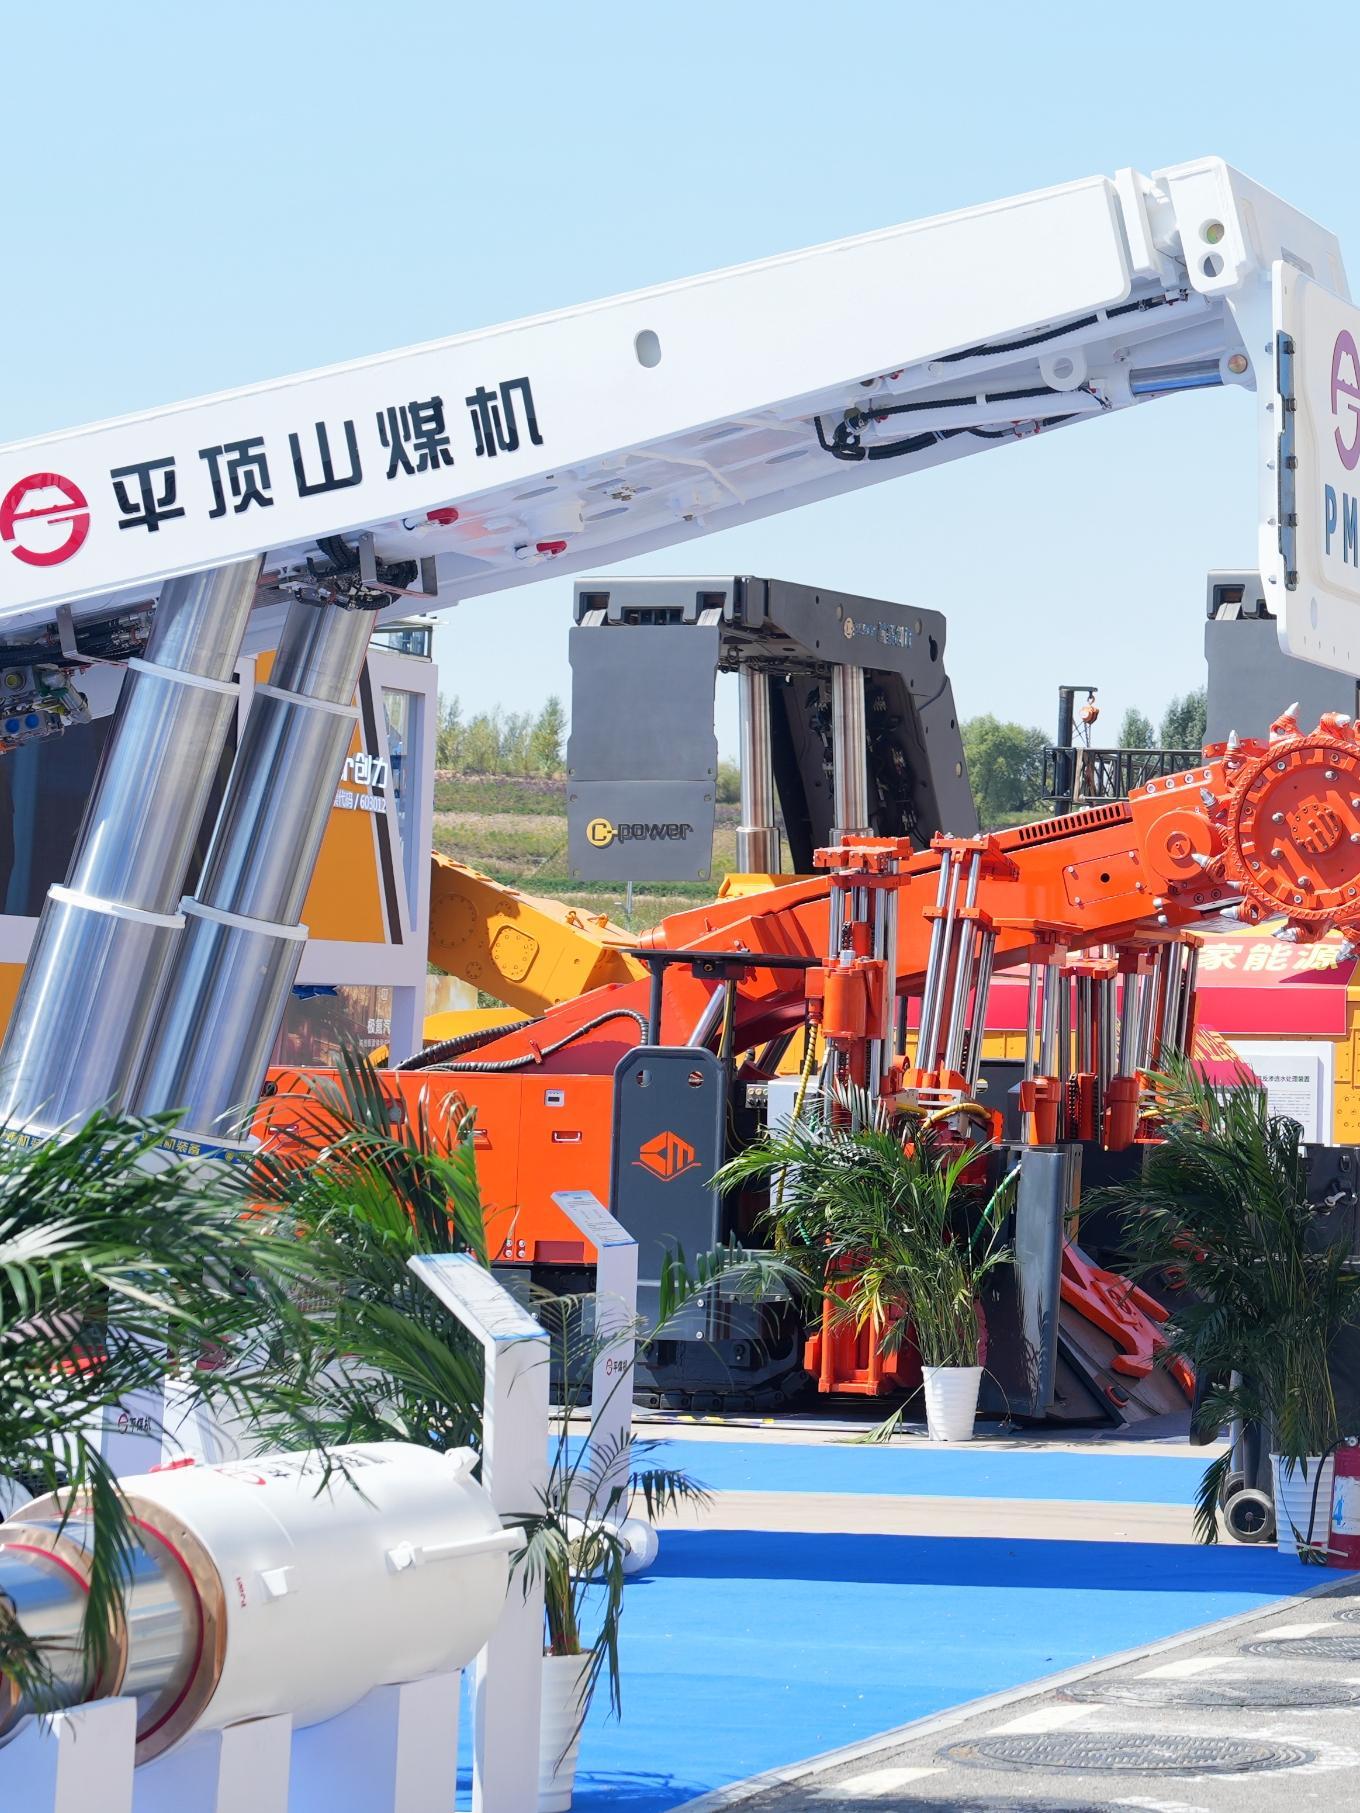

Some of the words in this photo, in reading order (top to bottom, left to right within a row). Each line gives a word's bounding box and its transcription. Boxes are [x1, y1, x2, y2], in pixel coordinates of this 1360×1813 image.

[110, 376, 544, 533] 平顶山煤机
[341, 752, 388, 789] r创力
[1181, 943, 1342, 972] 家能源
